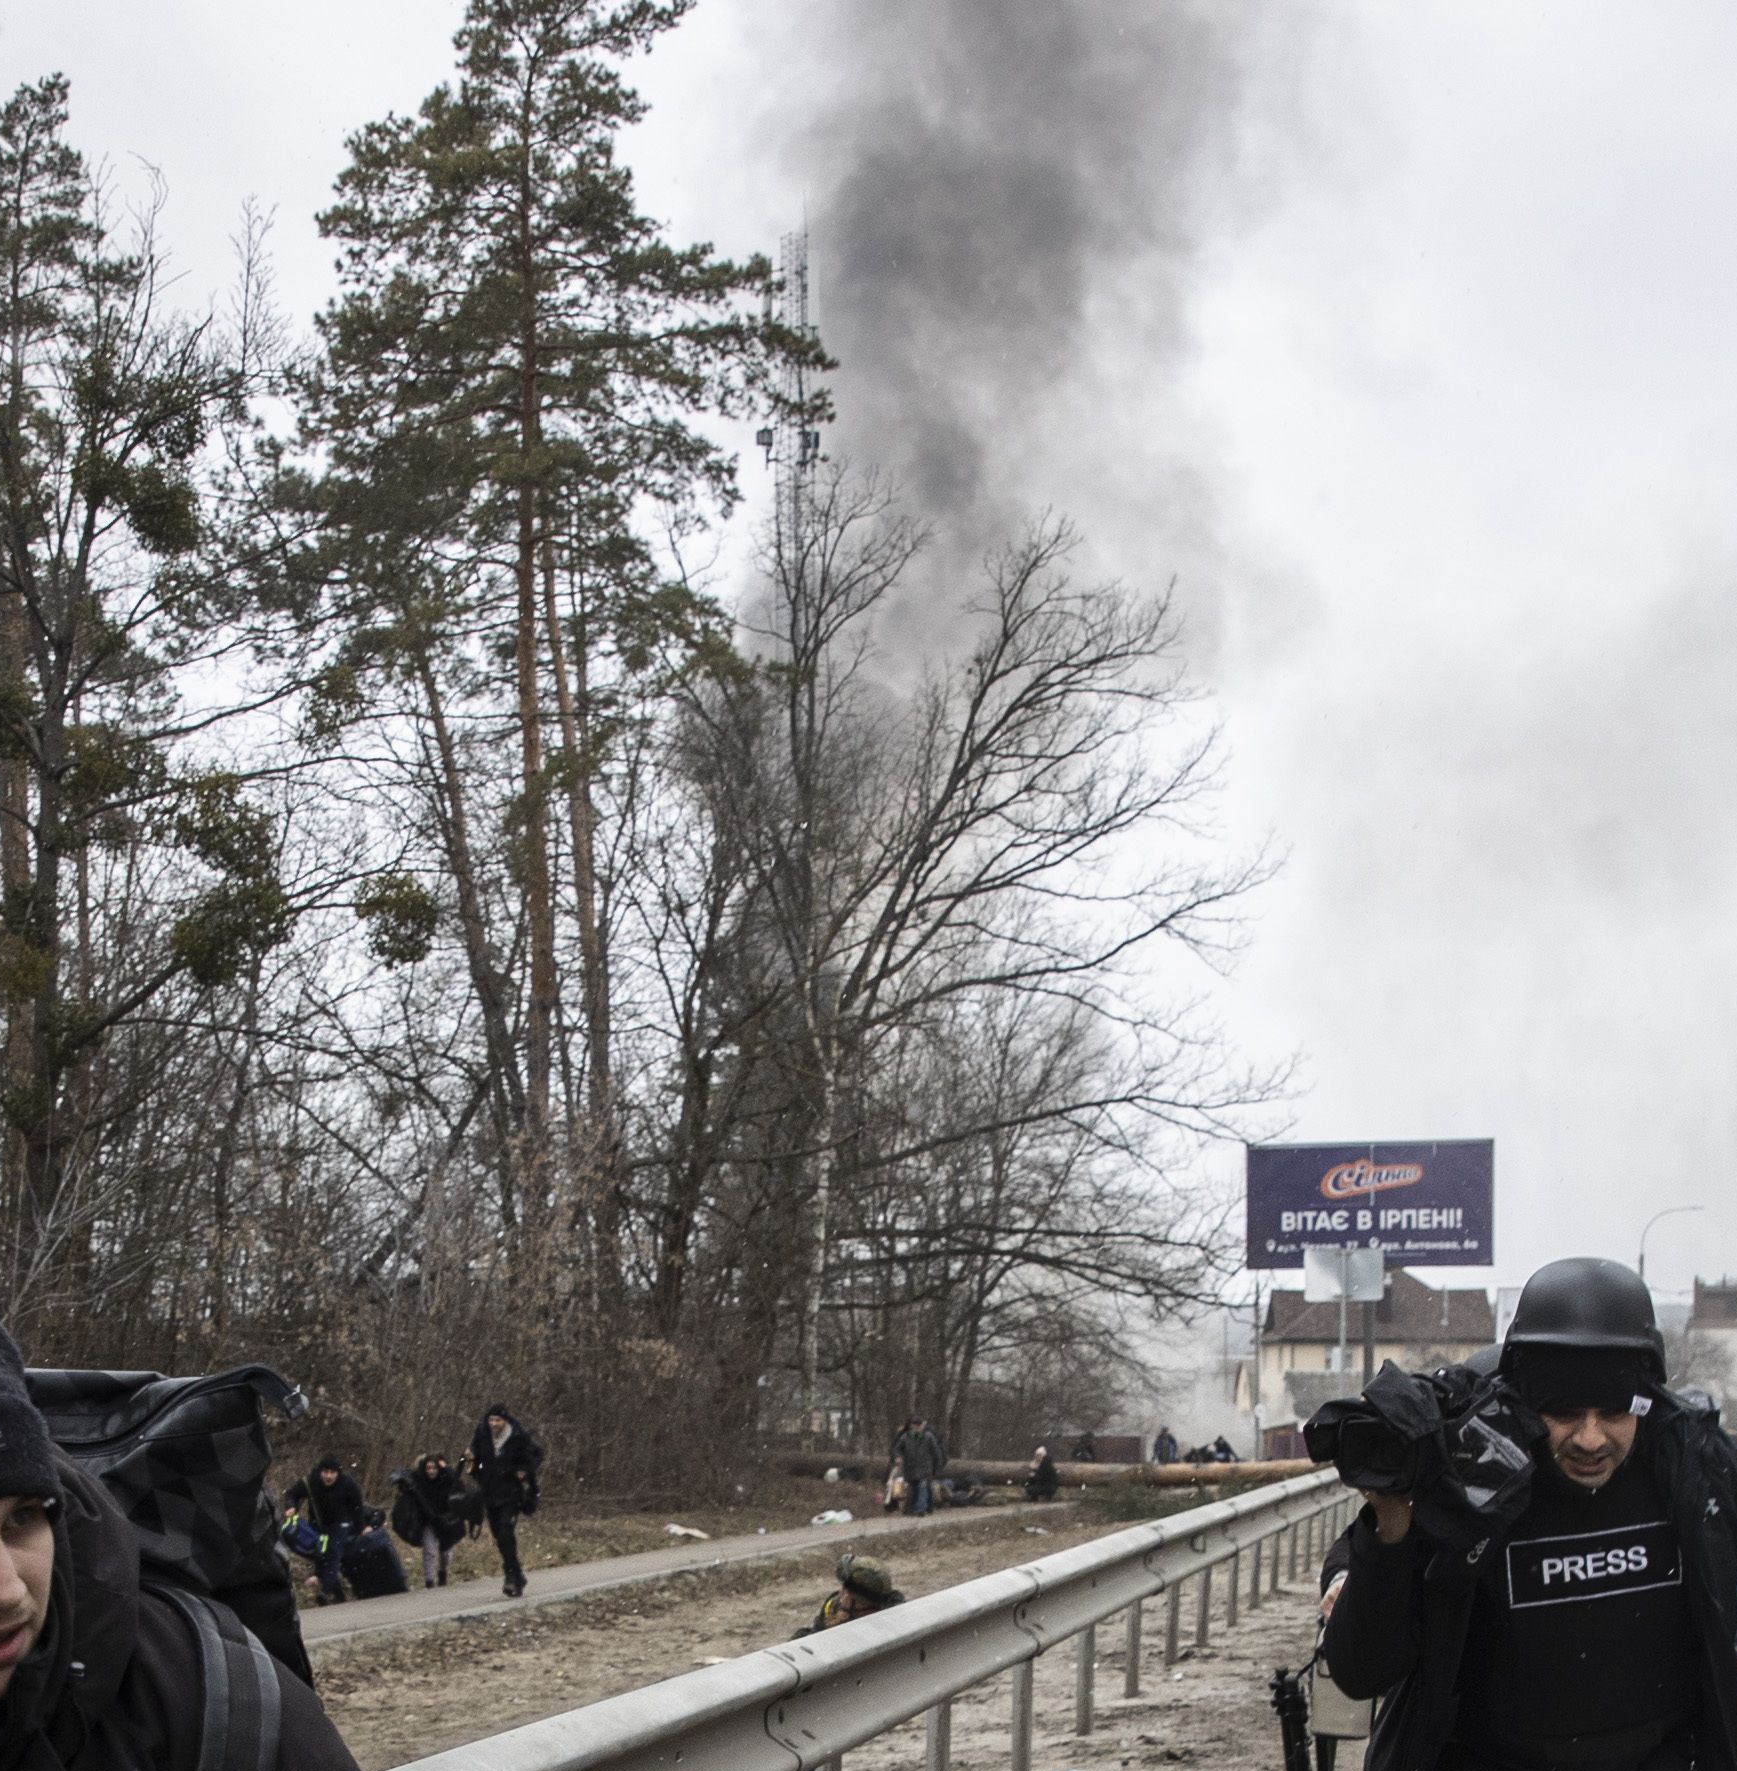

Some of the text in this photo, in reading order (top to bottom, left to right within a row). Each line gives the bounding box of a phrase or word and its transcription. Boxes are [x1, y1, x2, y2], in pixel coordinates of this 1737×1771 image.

[1281, 1208, 1463, 1232] ВІТАЄ В ІРПЕНІ!
[1542, 1545, 1648, 1585] PRESS
